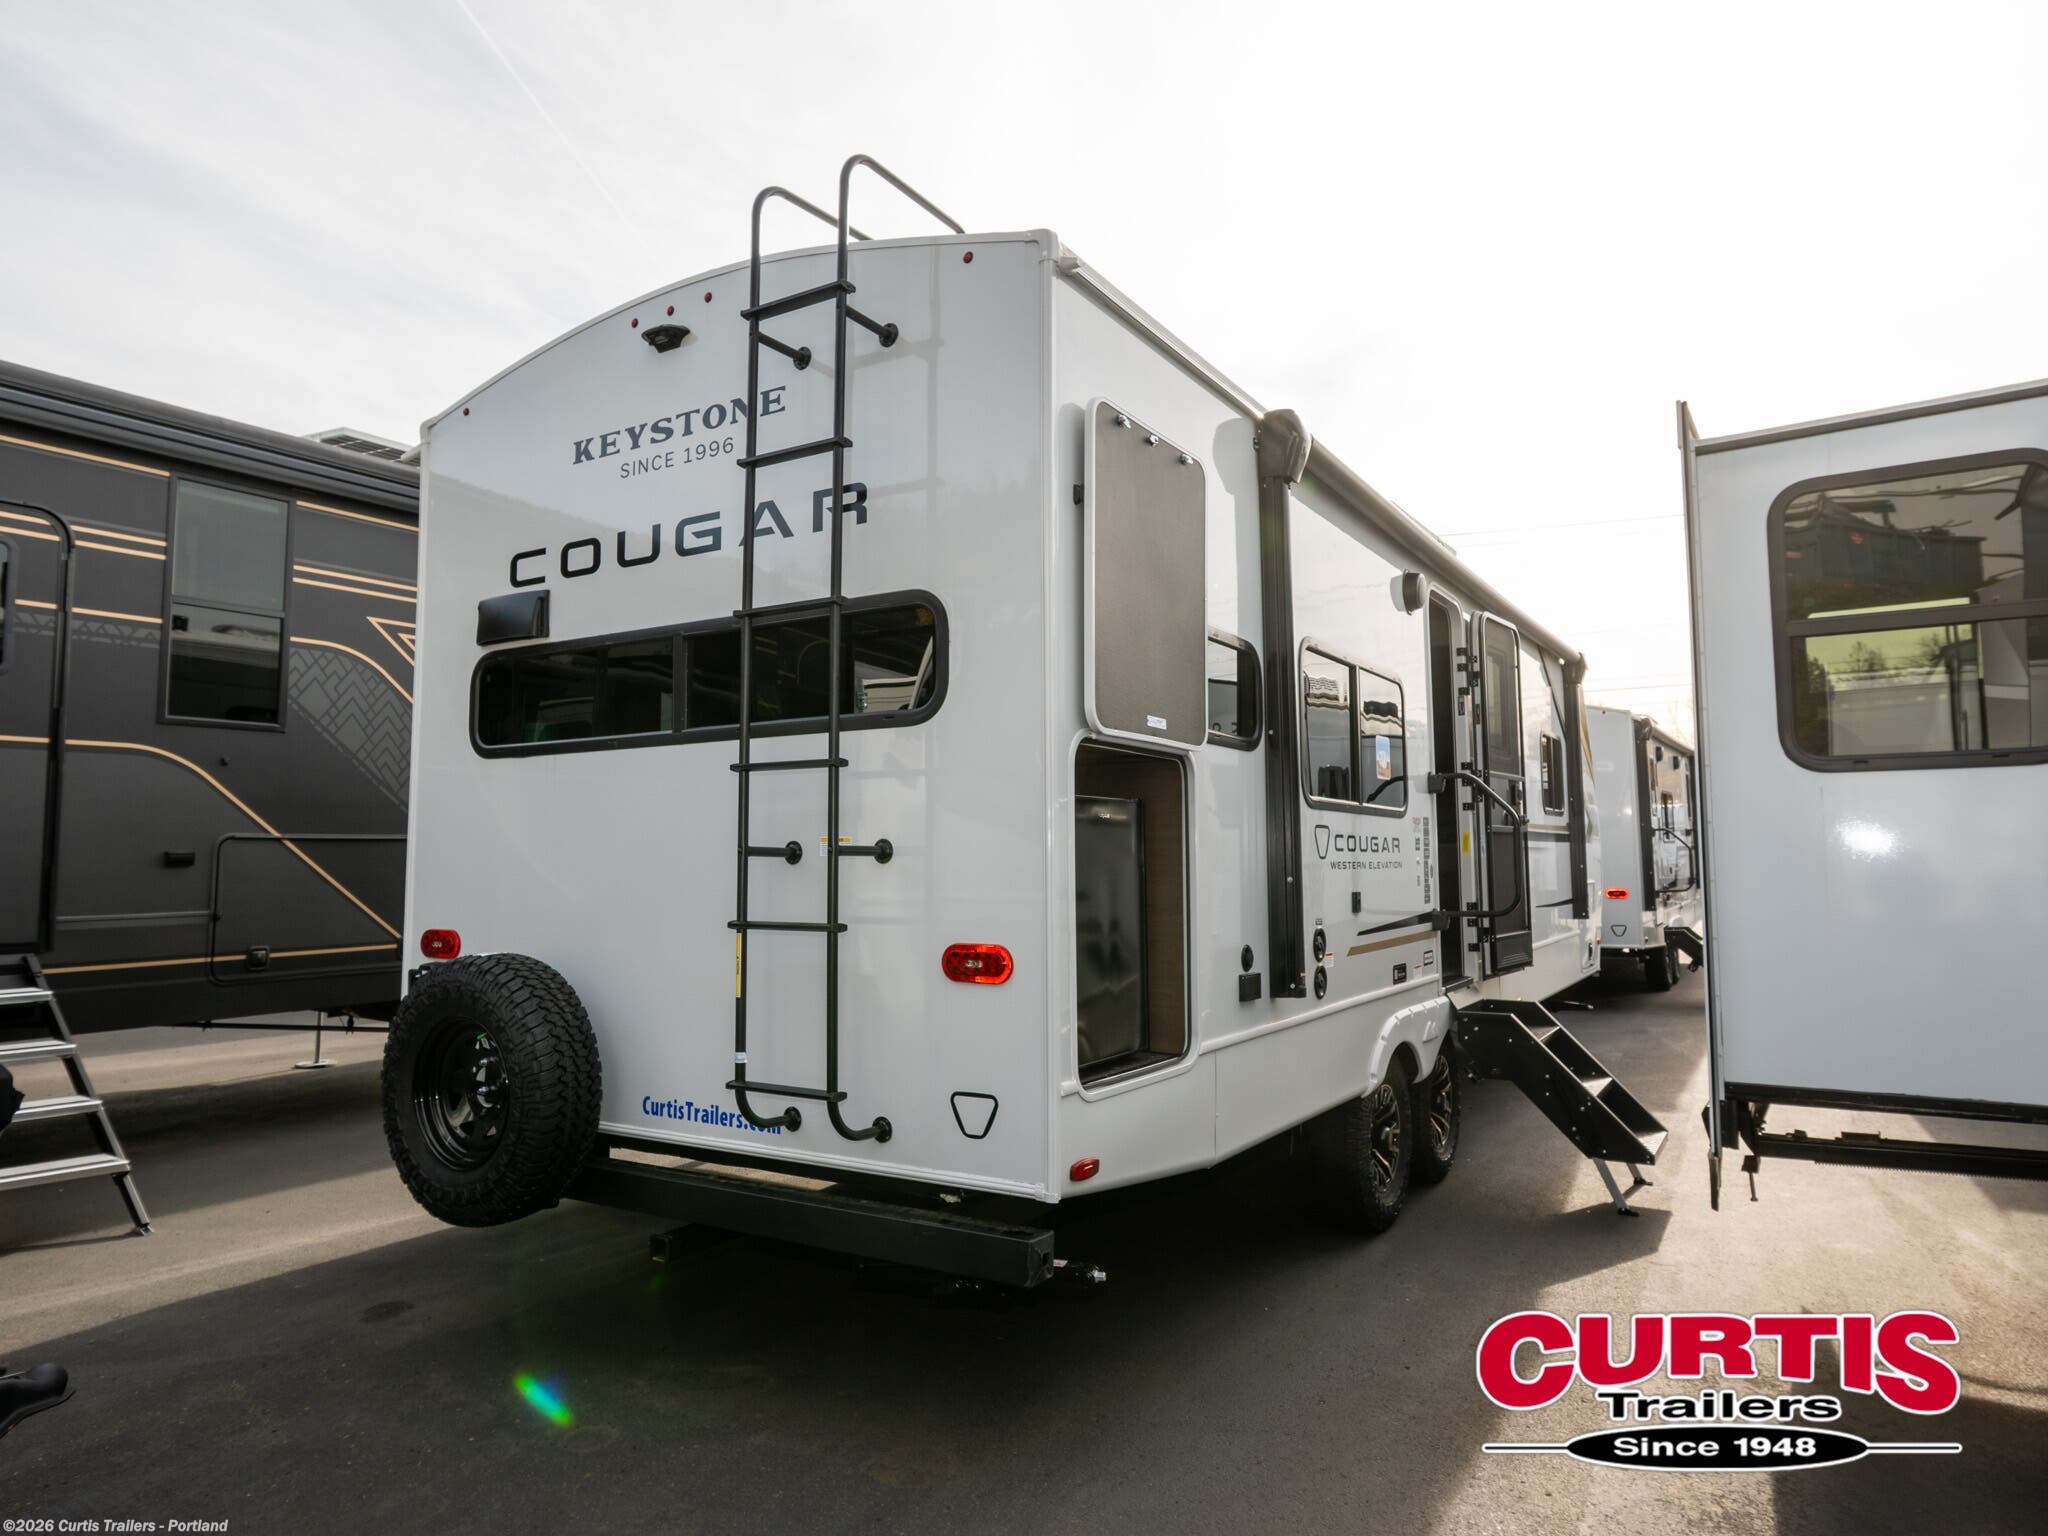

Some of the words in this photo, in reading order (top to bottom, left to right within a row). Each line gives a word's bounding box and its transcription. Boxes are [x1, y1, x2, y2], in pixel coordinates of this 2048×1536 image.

[572, 385, 786, 466] KEYSTONE
[620, 451, 675, 479] SINCE
[683, 437, 735, 464] 1996
[509, 482, 868, 589] COUGAR
[1334, 834, 1401, 853] COUGAR
[1330, 861, 1367, 871] WESTERN
[1368, 861, 1403, 870] ELEVATION
